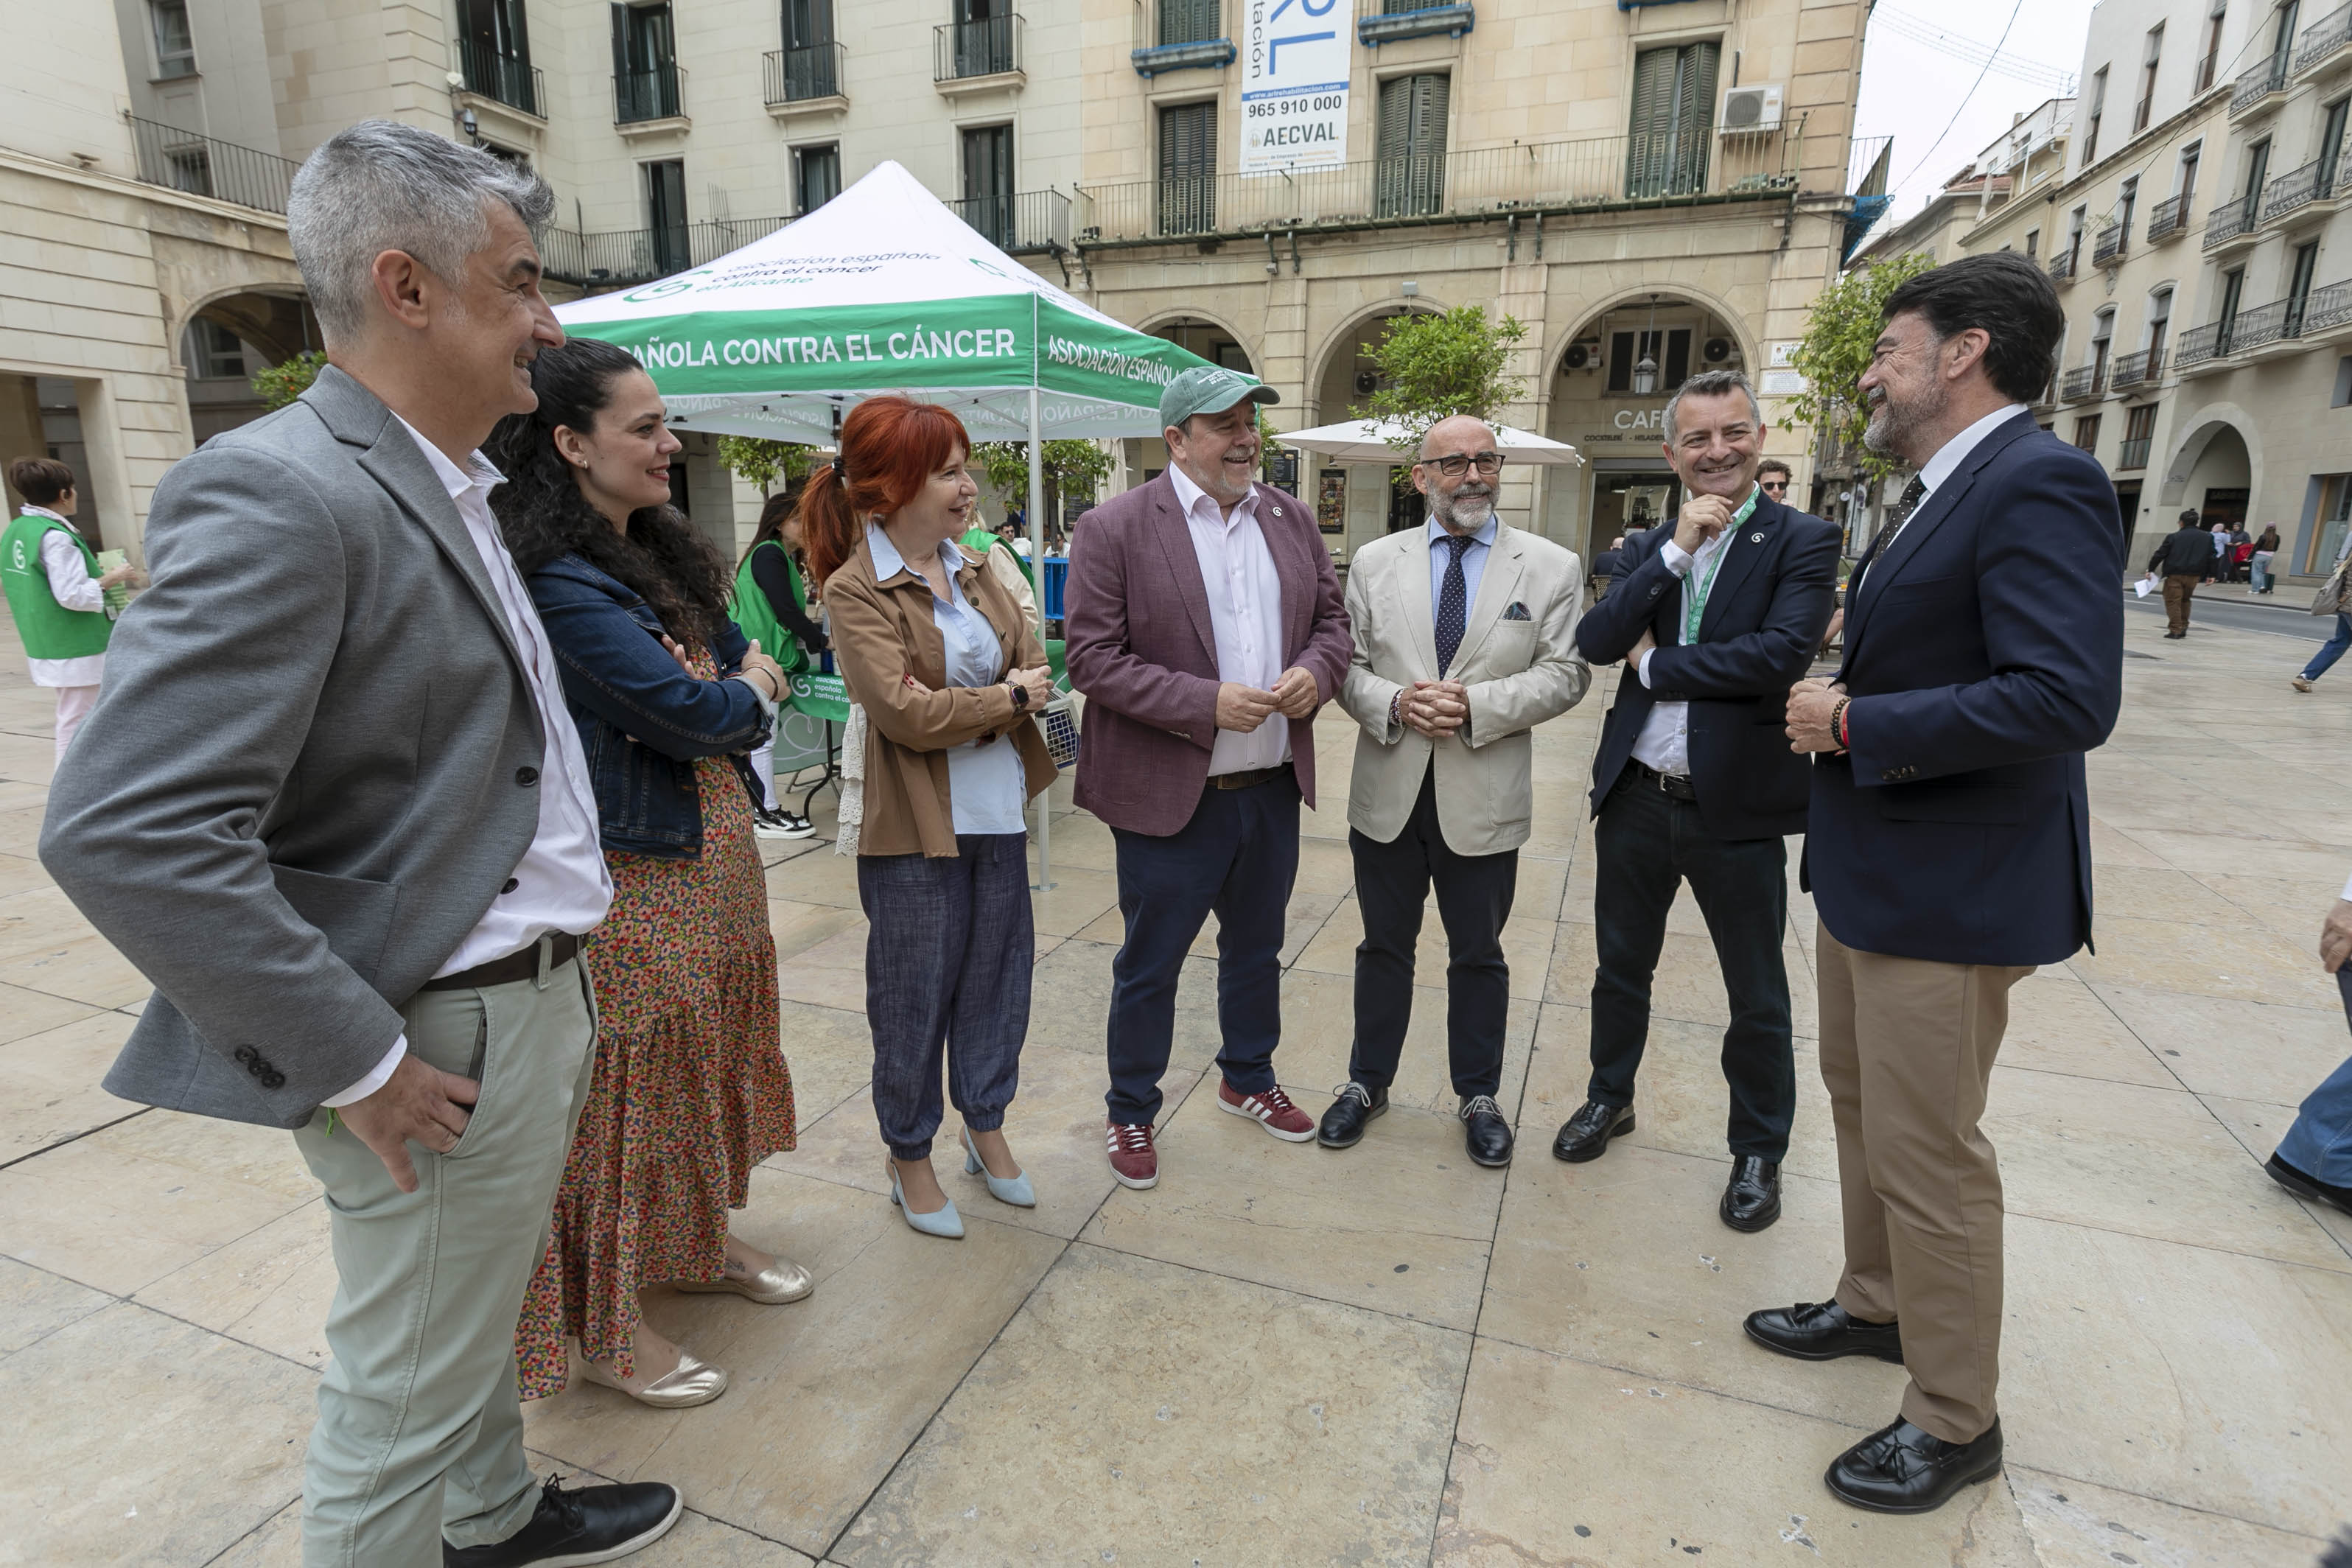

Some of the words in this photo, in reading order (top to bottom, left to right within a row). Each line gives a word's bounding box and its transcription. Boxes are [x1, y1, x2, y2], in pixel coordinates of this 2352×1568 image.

[1248, 103, 1275, 118] 965
[1281, 98, 1308, 115] 910
[1314, 95, 1342, 111] 000
[728, 255, 836, 272] asociación
[712, 270, 778, 283] contra
[781, 266, 805, 275] el
[805, 265, 883, 273] cáncer
[723, 337, 841, 365] CONTRA
[846, 334, 883, 362] EL
[887, 323, 1016, 360] CÁNCER
[1048, 334, 1130, 377] ASOCIACIÓN
[814, 692, 833, 700] contra
